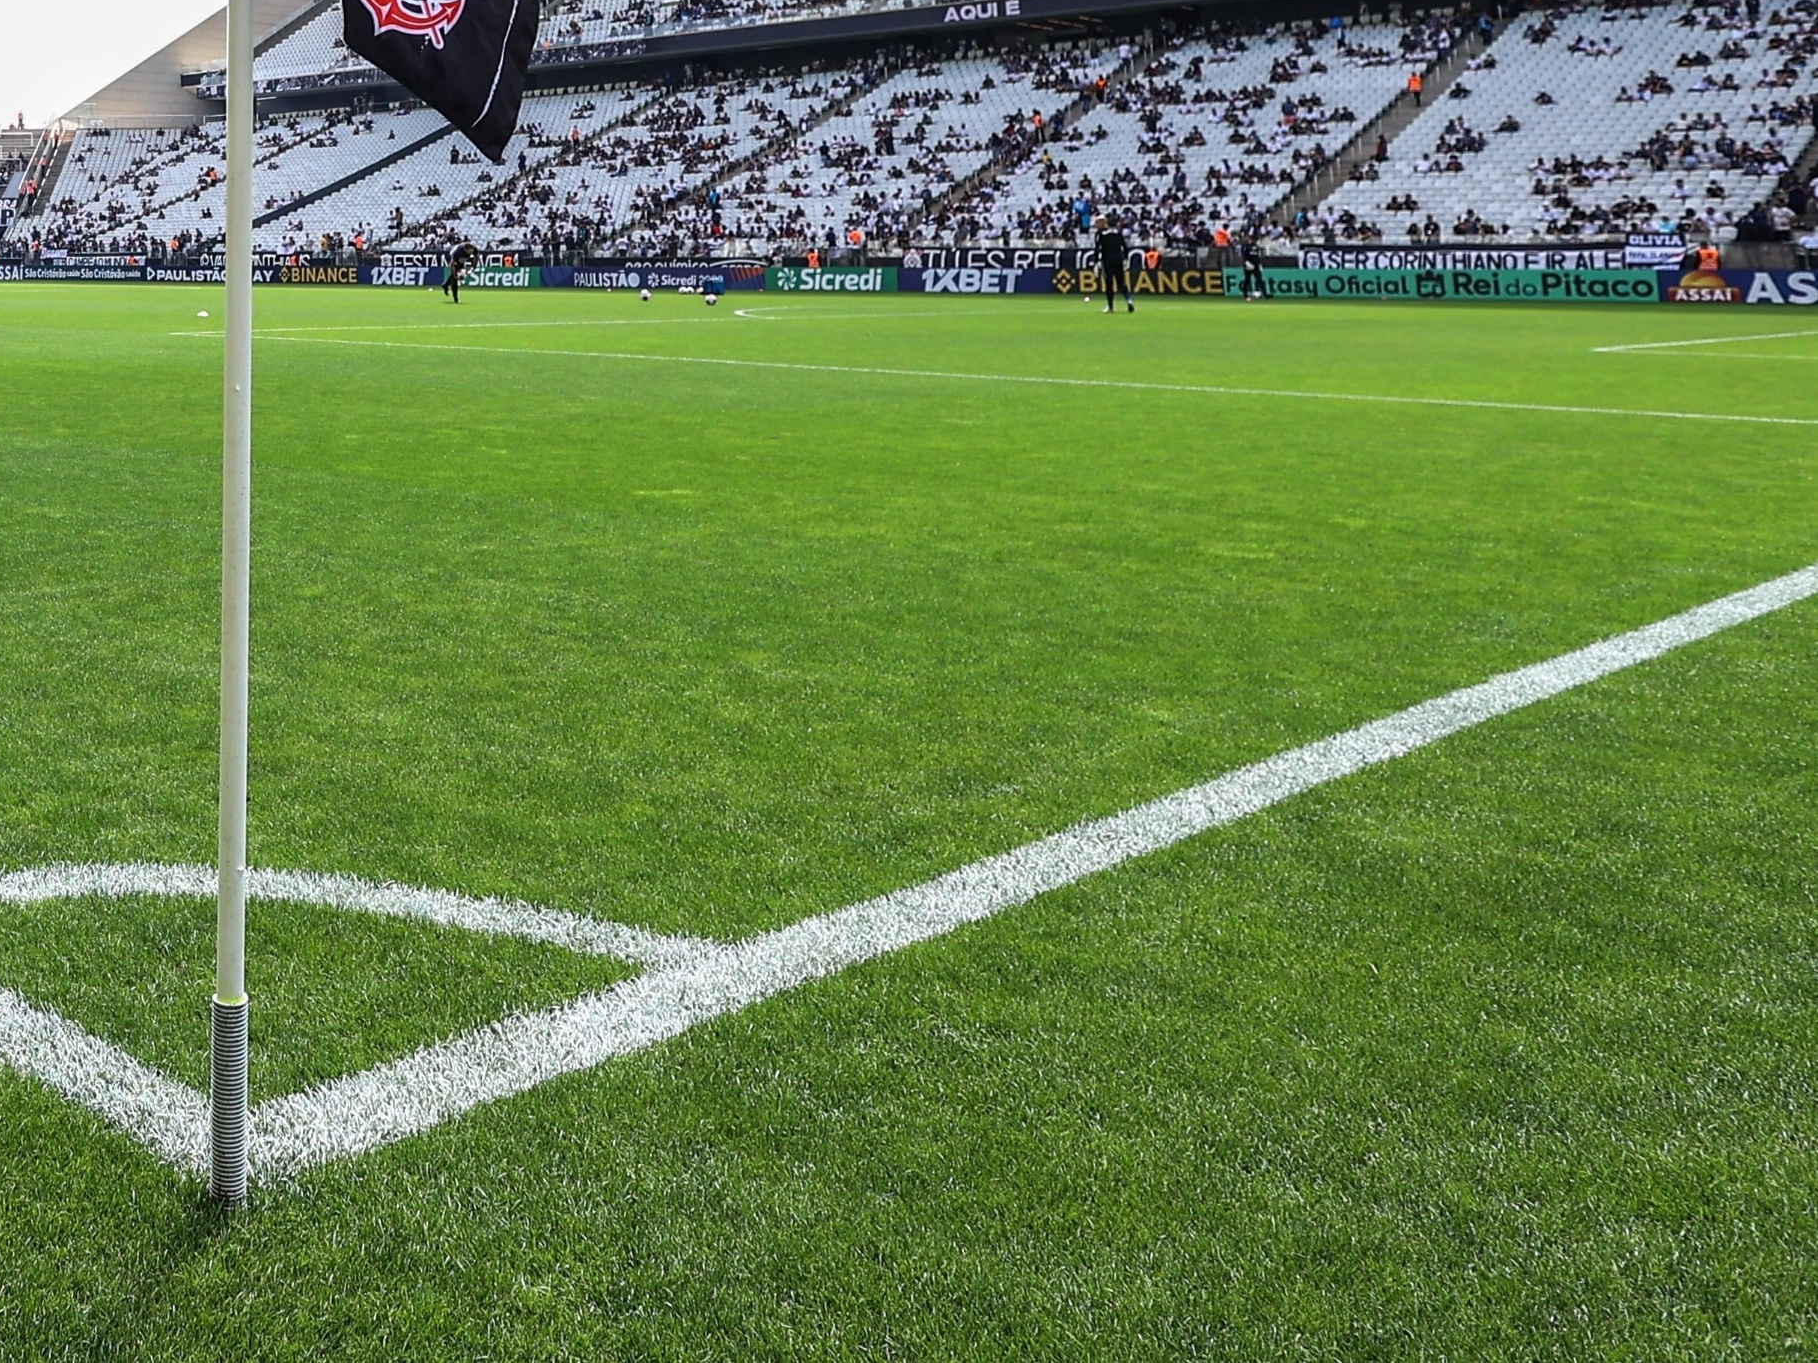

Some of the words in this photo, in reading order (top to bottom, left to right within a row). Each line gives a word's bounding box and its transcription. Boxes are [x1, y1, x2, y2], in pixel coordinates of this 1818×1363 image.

[944, 2, 998, 22] AQUI
[1629, 234, 1682, 245] OLIVIA
[25, 267, 36, 278] São
[37, 267, 66, 279] Cristóvão
[66, 268, 80, 277] saúde
[81, 267, 93, 278] São
[94, 267, 125, 279] Cristóvão
[125, 268, 141, 277] saúde
[291, 268, 357, 283] BINANCE
[370, 267, 429, 285] 1XBET
[469, 266, 530, 286] Sicredi
[574, 270, 641, 287] PAULISTÃO
[661, 274, 697, 286] Sicredi
[800, 268, 882, 291] Sicredi
[922, 268, 1022, 294] 1XBET
[1325, 274, 1409, 295] Oficial
[1453, 272, 1500, 296] Rei
[1504, 278, 1538, 296] do
[1541, 272, 1654, 297] Pitaco
[1675, 287, 1733, 302] ASSAÍ
